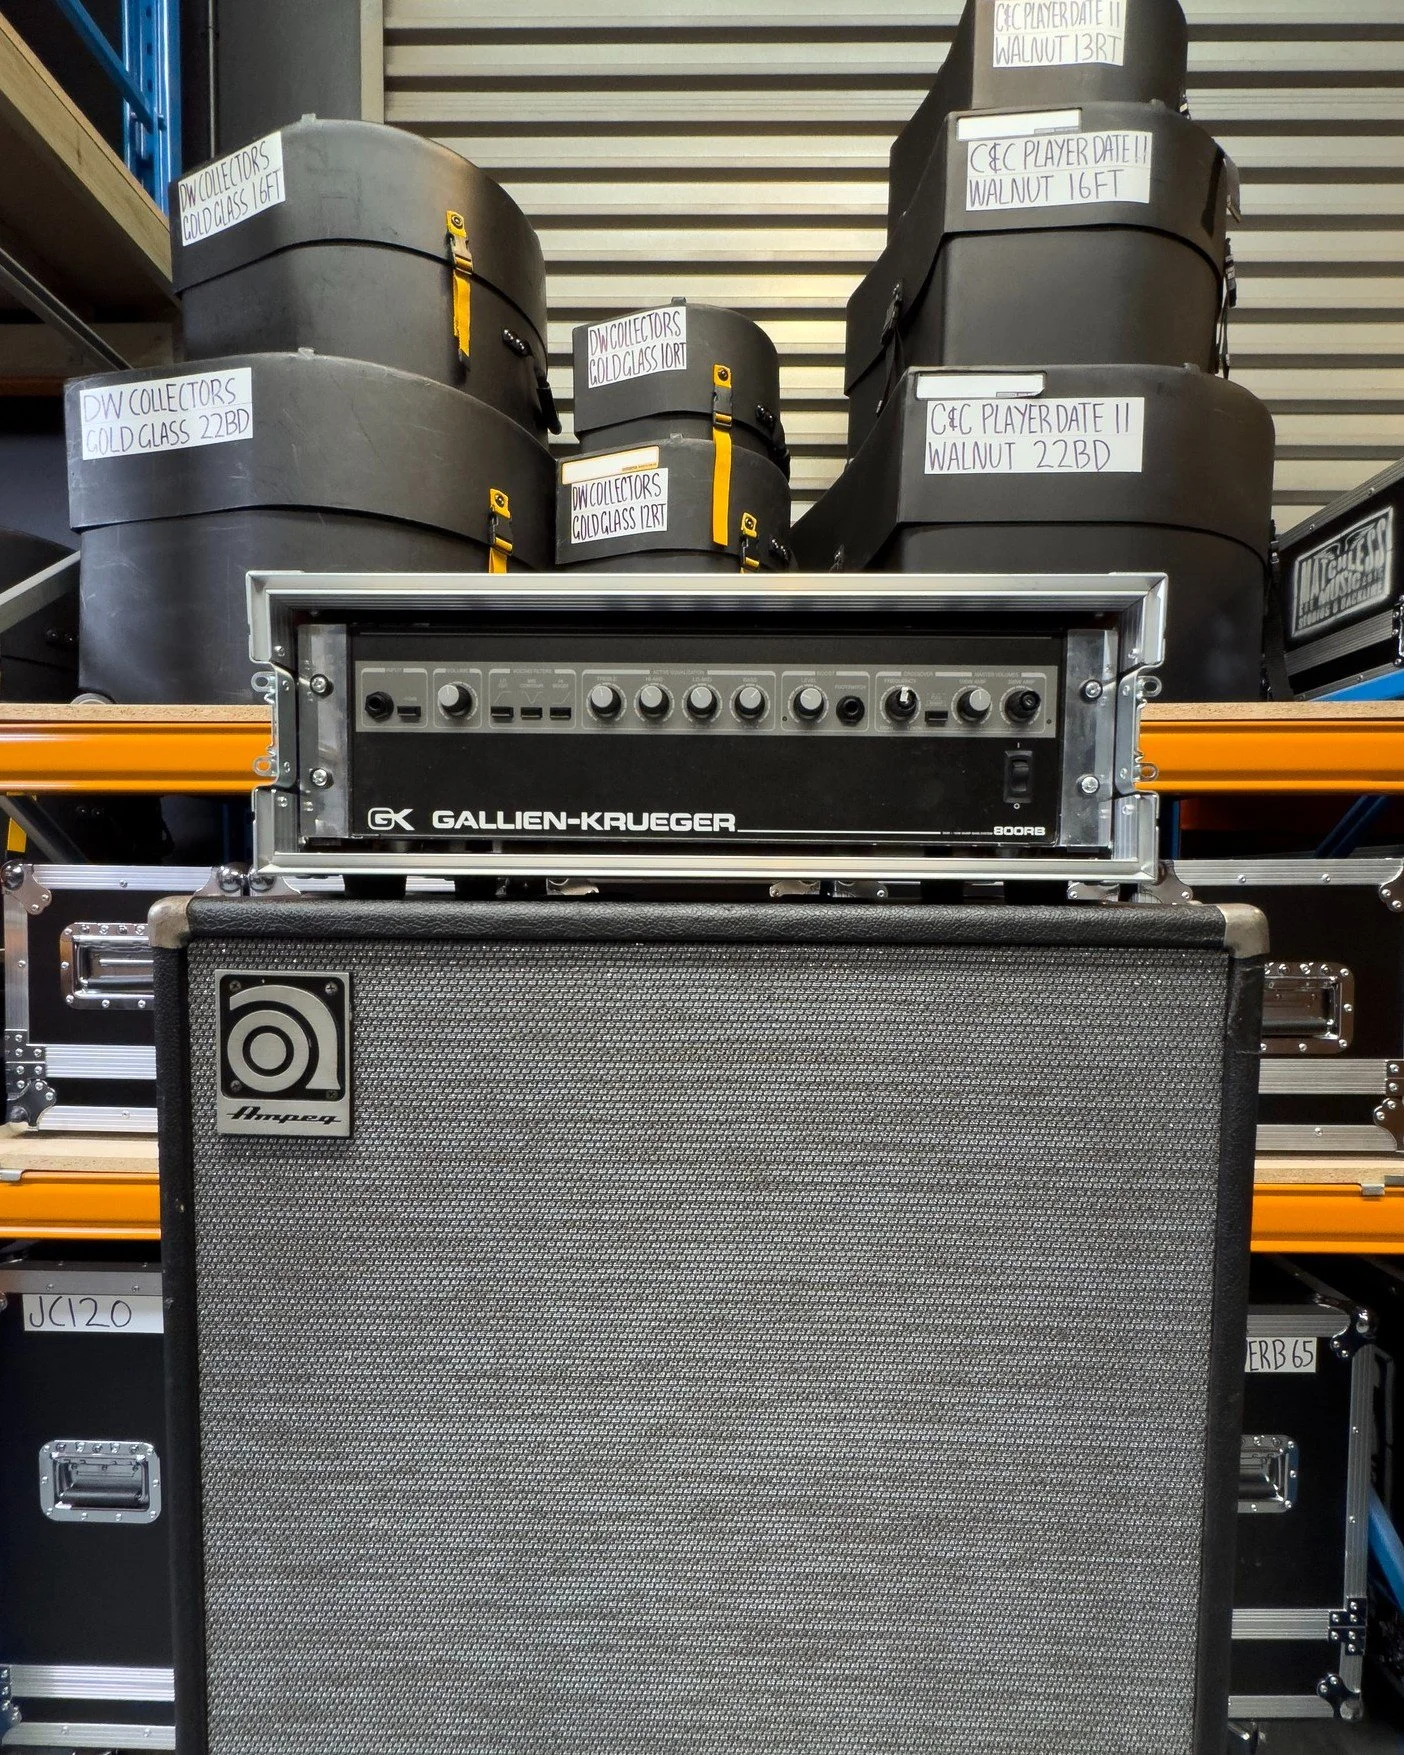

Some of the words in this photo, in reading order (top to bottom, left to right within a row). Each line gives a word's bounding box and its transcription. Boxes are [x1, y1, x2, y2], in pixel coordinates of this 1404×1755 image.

[996, 2, 1021, 32] C&C
[995, 34, 1070, 65] WALNUT
[1075, 32, 1122, 63] 13RT
[970, 142, 1016, 174] C&C
[1023, 137, 1088, 170] PLAYER
[1093, 134, 1129, 164] DATE
[179, 179, 197, 212] DW
[198, 140, 270, 202] COLLECTORS
[969, 175, 1055, 208] WALNUT
[1069, 169, 1125, 201] 16FT
[182, 207, 212, 241] GOLD
[214, 188, 249, 227] GLASS
[252, 168, 281, 210] 16FT
[589, 325, 608, 356] DW
[609, 310, 682, 350] COLLECTORS
[589, 353, 621, 386] GOLD
[623, 344, 658, 377] GLASS
[83, 390, 123, 422] DW
[129, 377, 236, 416] COLLECTORS
[86, 425, 134, 456] GOLD
[138, 418, 191, 450] GLASS
[198, 408, 250, 440] 22BD
[930, 402, 972, 436] C&C
[928, 440, 1016, 471] WALNUT
[1033, 439, 1111, 472] 22BD
[572, 483, 588, 512] DW
[589, 472, 662, 507] COLLECTORS
[572, 513, 599, 541] GOLD
[600, 506, 636, 535] GLASS
[640, 503, 667, 530] 12RT
[1319, 569, 1362, 606] MUSIC
[367, 807, 415, 831] GK
[432, 810, 736, 832] GALLIEN-KRUEGER
[993, 825, 1046, 836] 800RB
[226, 1105, 342, 1125] Ampeg
[29, 1295, 132, 1328] JC120
